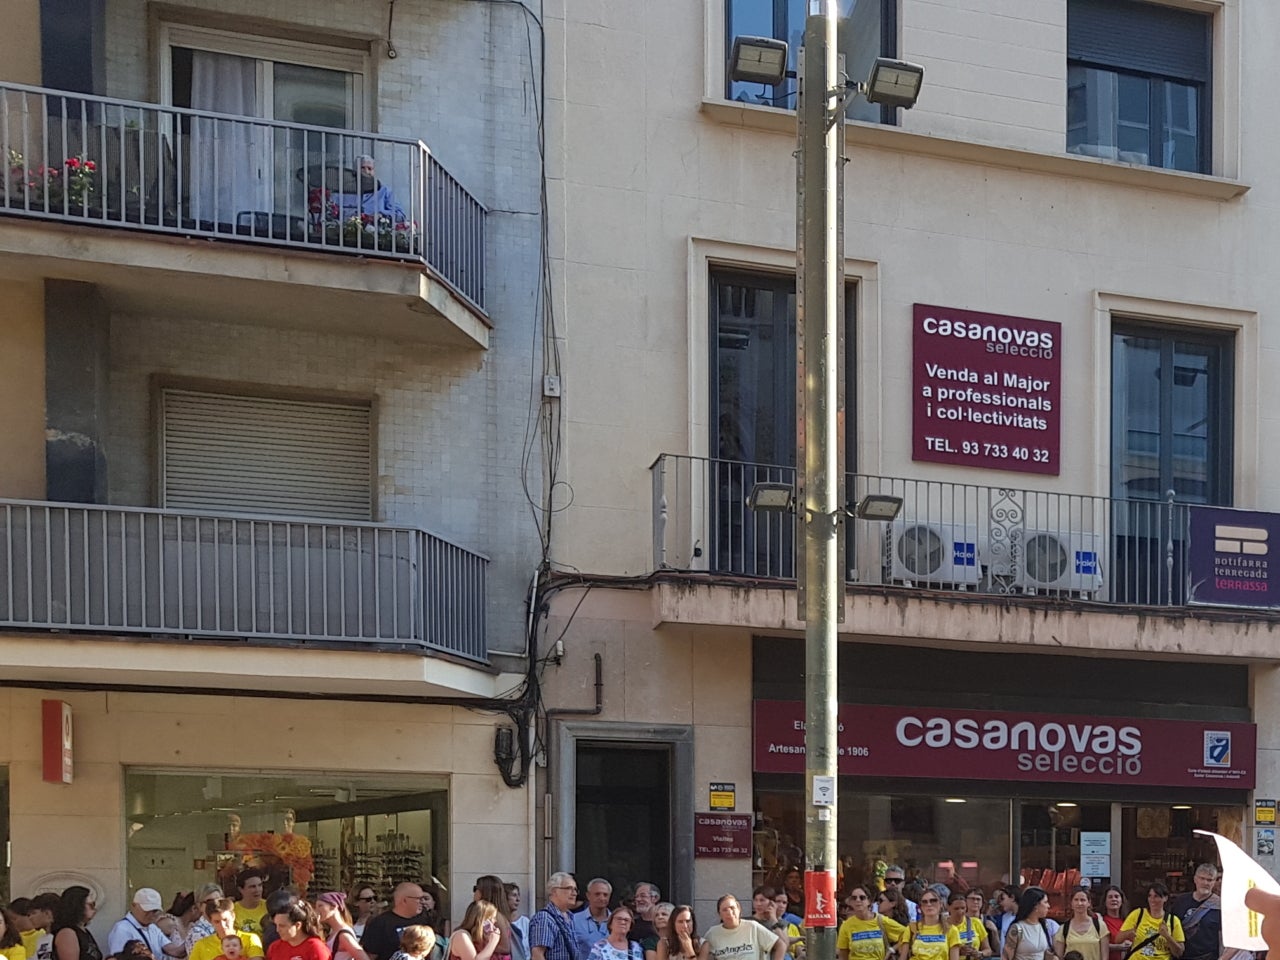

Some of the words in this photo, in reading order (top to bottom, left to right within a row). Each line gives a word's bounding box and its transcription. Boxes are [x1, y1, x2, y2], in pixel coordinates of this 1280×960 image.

[923, 317, 1053, 349] casanovas
[925, 363, 978, 383] Venda
[984, 372, 998, 386] al
[1003, 373, 1050, 393] Major
[922, 386, 932, 398] a
[937, 388, 1052, 412] professionals
[926, 403, 932, 418] i
[925, 437, 958, 453] TEL.
[962, 441, 979, 455] 93
[983, 443, 1008, 458] 733
[1012, 446, 1029, 461] 40
[1033, 449, 1049, 463] 32
[895, 715, 1142, 756] casanovas
[768, 743, 806, 754] Artesan
[847, 746, 869, 756] 1906
[1017, 750, 1142, 775] selecció
[698, 818, 748, 826] casanovas
